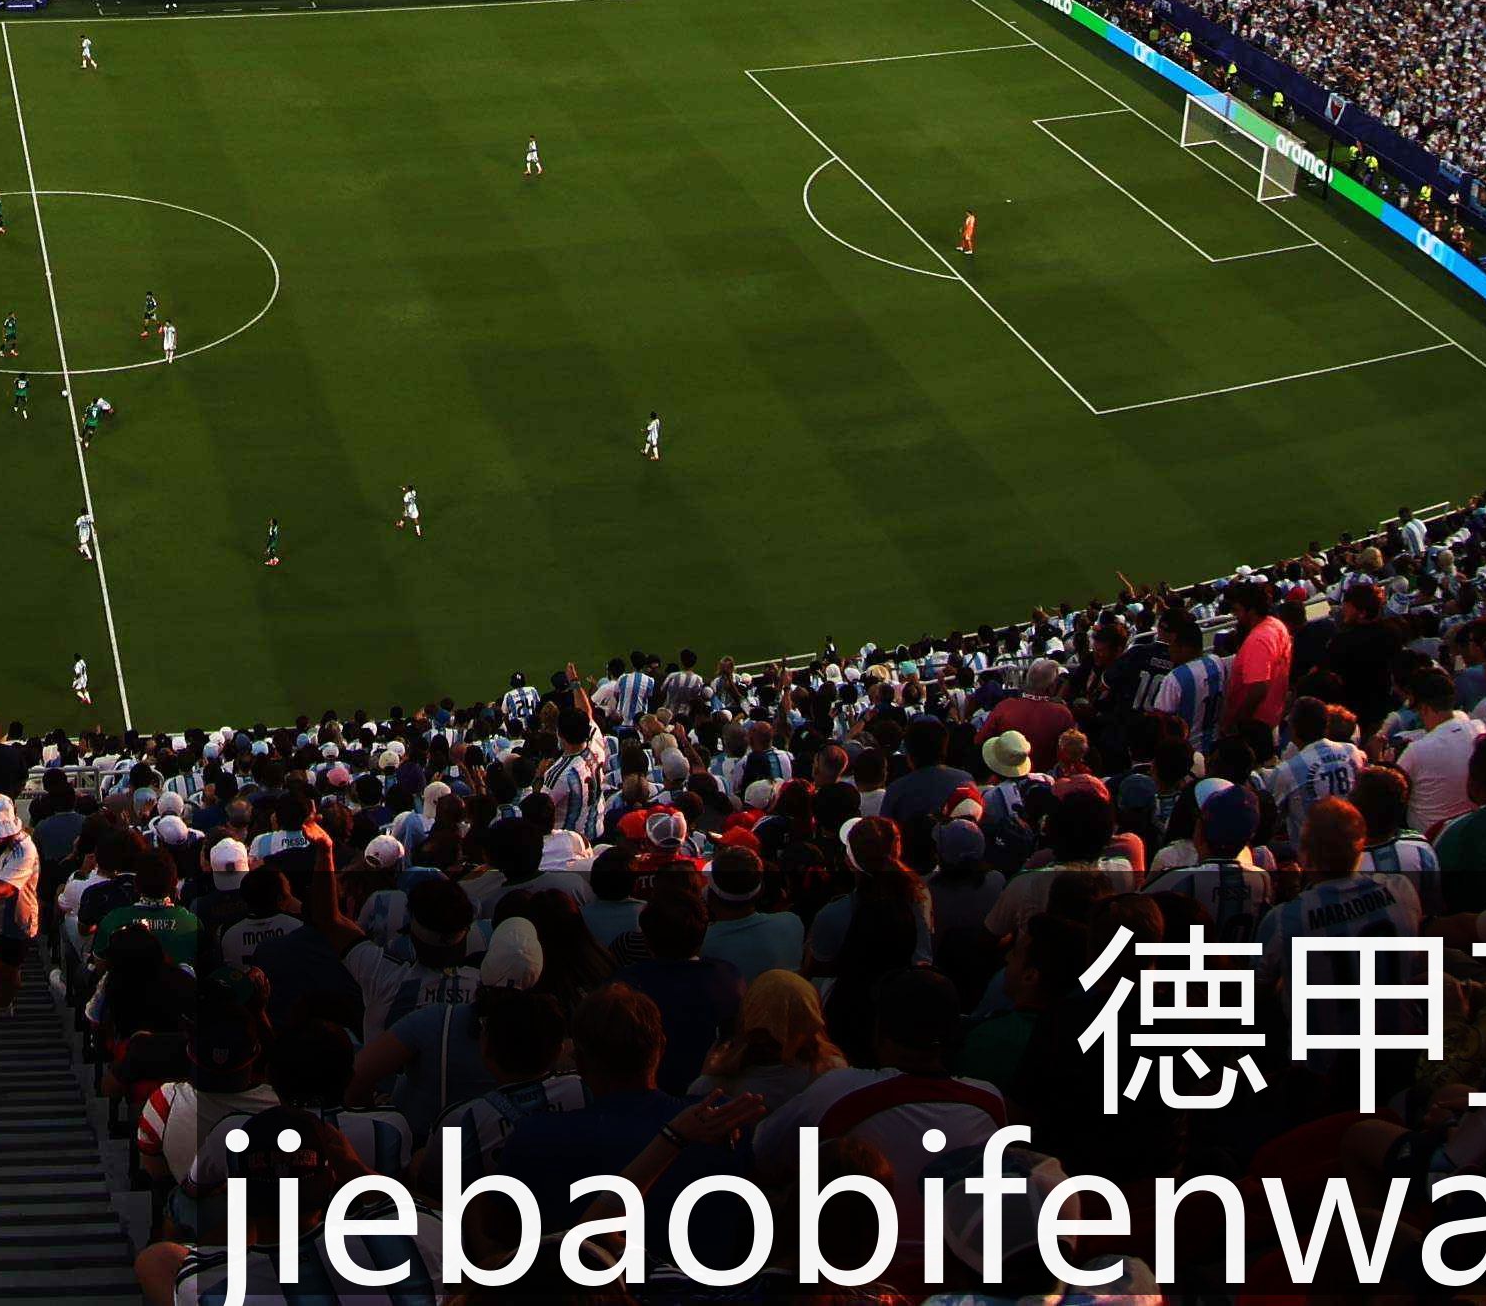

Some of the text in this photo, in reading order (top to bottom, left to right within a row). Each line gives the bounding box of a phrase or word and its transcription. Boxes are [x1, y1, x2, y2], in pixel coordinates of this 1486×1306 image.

[1276, 133, 1334, 184] aramco
[1320, 764, 1348, 794] 78
[1307, 885, 1396, 931] MARADONA
[425, 988, 472, 1006] MESSI
